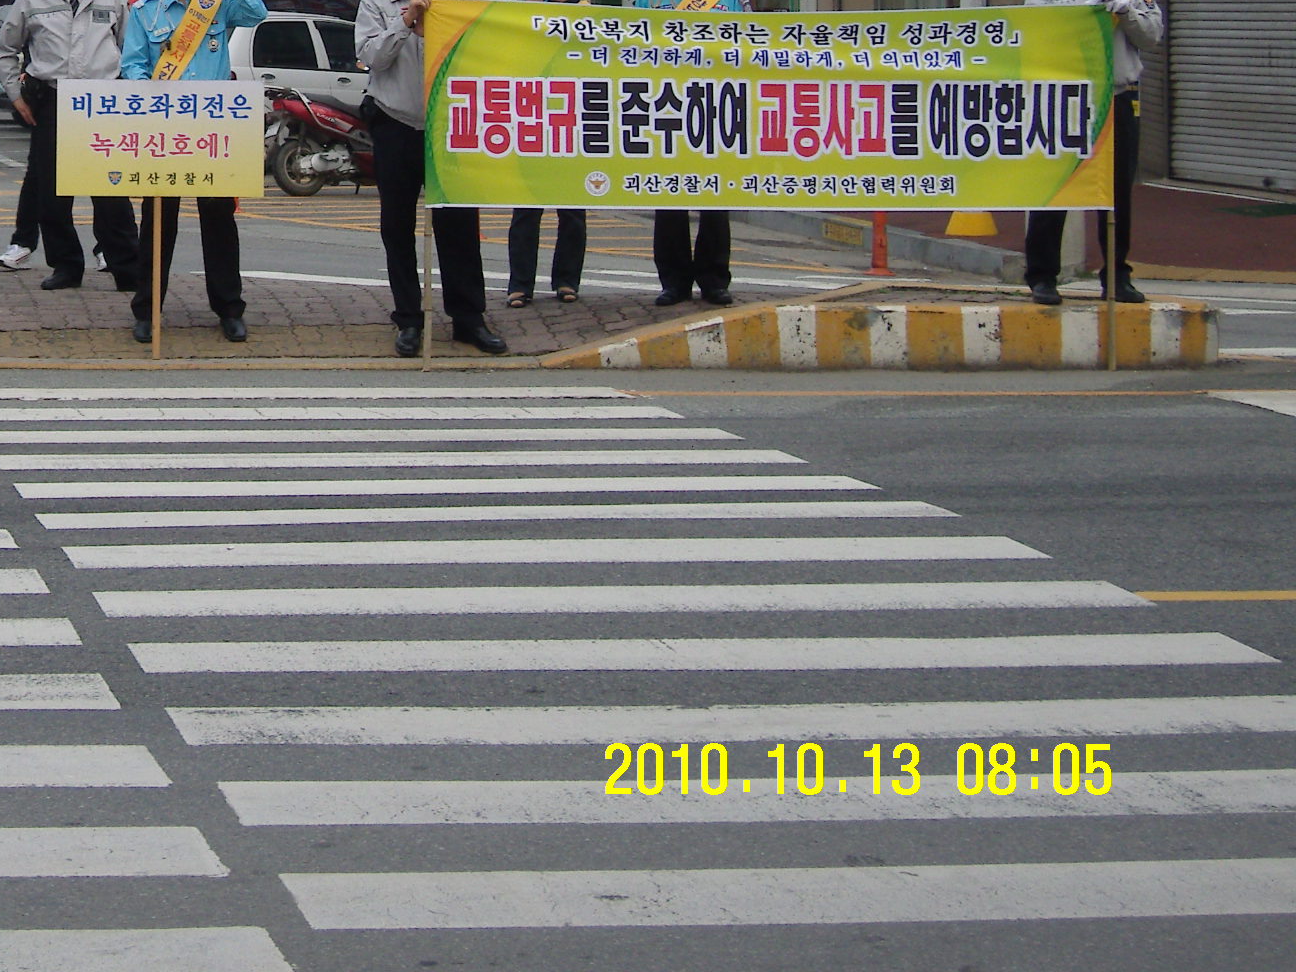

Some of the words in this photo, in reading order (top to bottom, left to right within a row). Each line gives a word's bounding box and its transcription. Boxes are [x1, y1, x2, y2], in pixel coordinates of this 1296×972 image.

[664, 20, 771, 45] 창조하는
[783, 23, 887, 47] 자율책임
[592, 47, 609, 67] 더
[620, 48, 712, 69] 진지하게,
[724, 49, 741, 68] 더
[752, 50, 844, 69] 세밀하게,
[853, 50, 871, 69] 더
[881, 49, 964, 71] 의미있게
[70, 92, 253, 120] 비보호좌회전은
[449, 80, 611, 156] 교통법규를
[621, 80, 748, 157] 준수하여
[759, 82, 921, 158] 교통사고를
[929, 82, 1093, 158] 예방합시다
[89, 132, 230, 159] 녹색신호에!
[128, 171, 215, 186] 괴산경찰서
